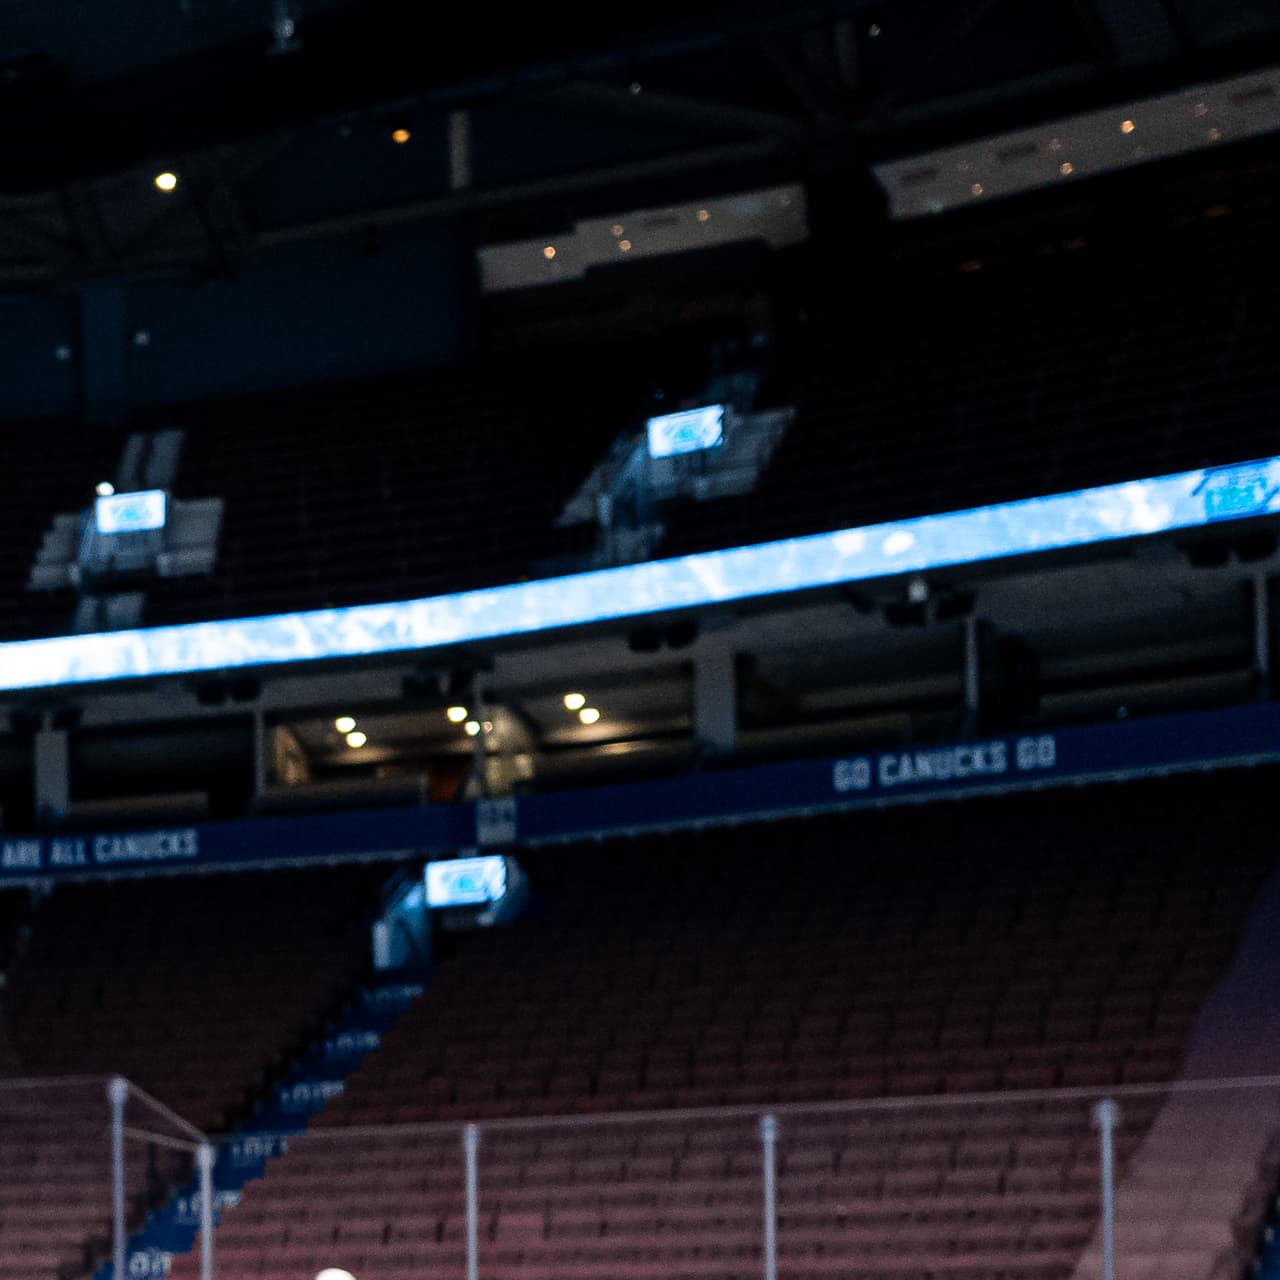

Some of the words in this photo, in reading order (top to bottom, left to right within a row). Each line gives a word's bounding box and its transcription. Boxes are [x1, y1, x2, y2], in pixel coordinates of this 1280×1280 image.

[879, 740, 1008, 788] CANUCKS
[1, 839, 41, 868] ARE
[50, 837, 86, 865] ALL
[94, 828, 198, 863] CANUCKS
